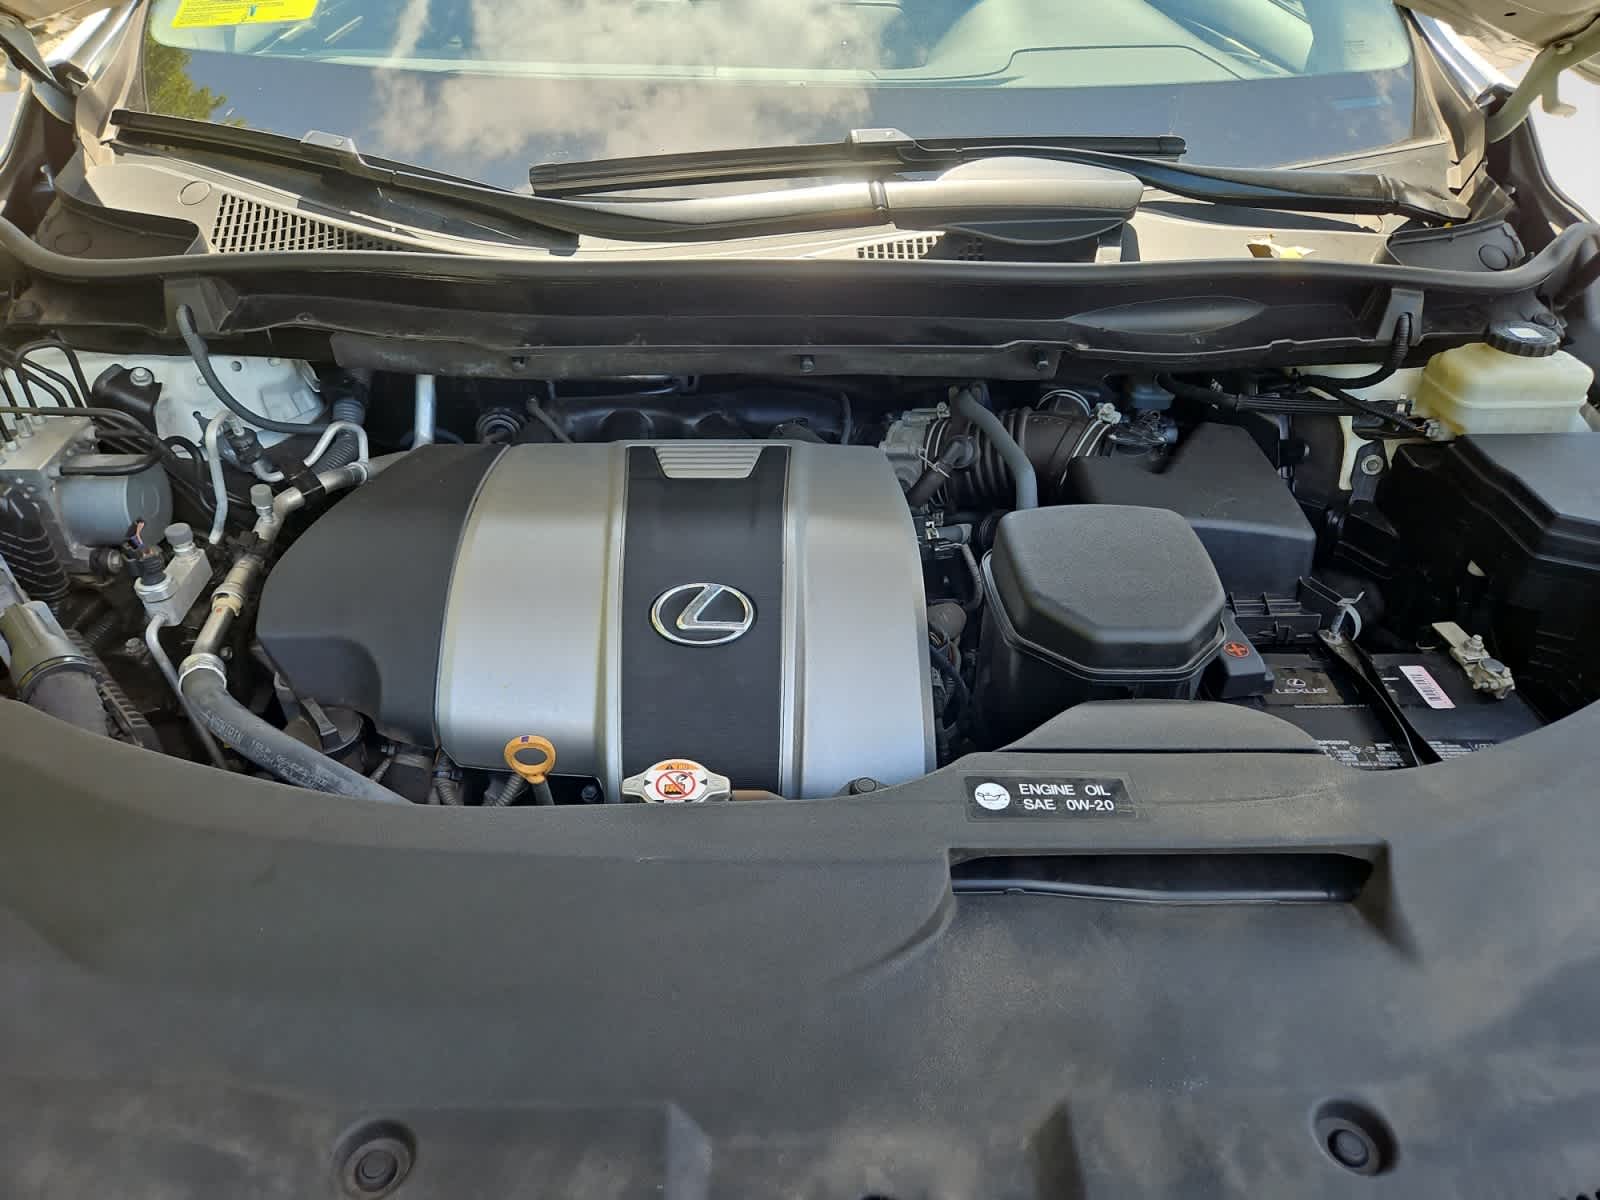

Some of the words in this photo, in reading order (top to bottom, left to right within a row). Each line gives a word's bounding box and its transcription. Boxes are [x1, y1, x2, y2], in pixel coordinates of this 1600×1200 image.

[1018, 783, 1076, 796] ENGINE
[1084, 784, 1111, 796] OIL
[1023, 798, 1057, 811] SAE
[1066, 799, 1114, 811] 0W-20
